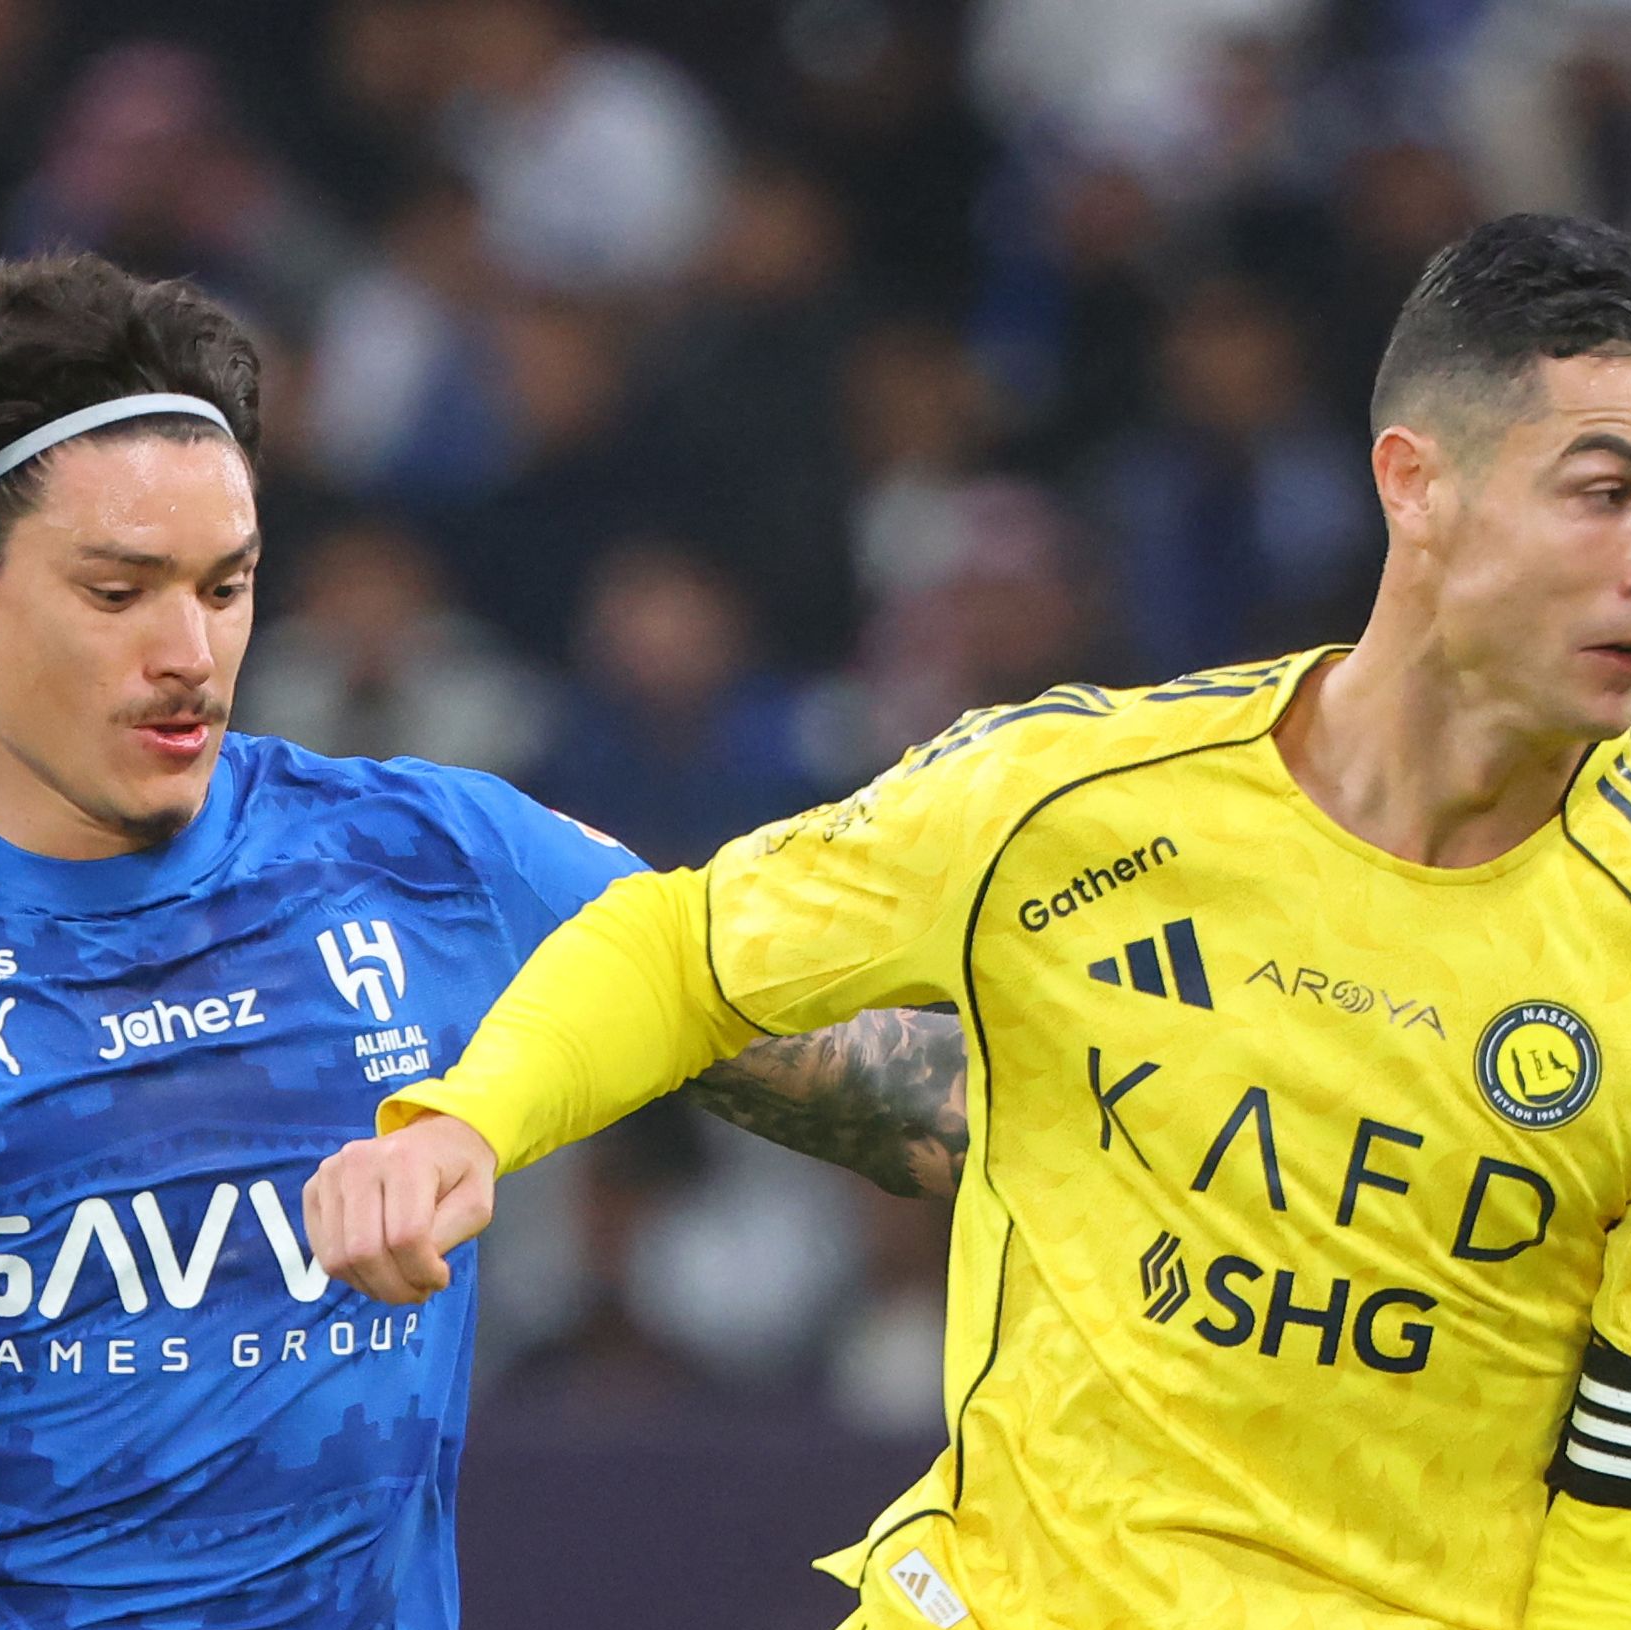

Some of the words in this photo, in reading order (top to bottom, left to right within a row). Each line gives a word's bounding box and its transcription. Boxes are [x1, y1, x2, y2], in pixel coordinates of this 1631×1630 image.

[1018, 836, 1178, 932] Gathern
[1244, 959, 1446, 1041] AROYA
[1522, 1008, 1579, 1035] NASSR
[354, 1025, 428, 1057] ALHILAL
[1492, 1089, 1532, 1121] RIYADH
[1087, 1046, 1557, 1263] KAFD
[231, 1312, 419, 1370] GROUP
[1195, 1251, 1438, 1374] SHG
